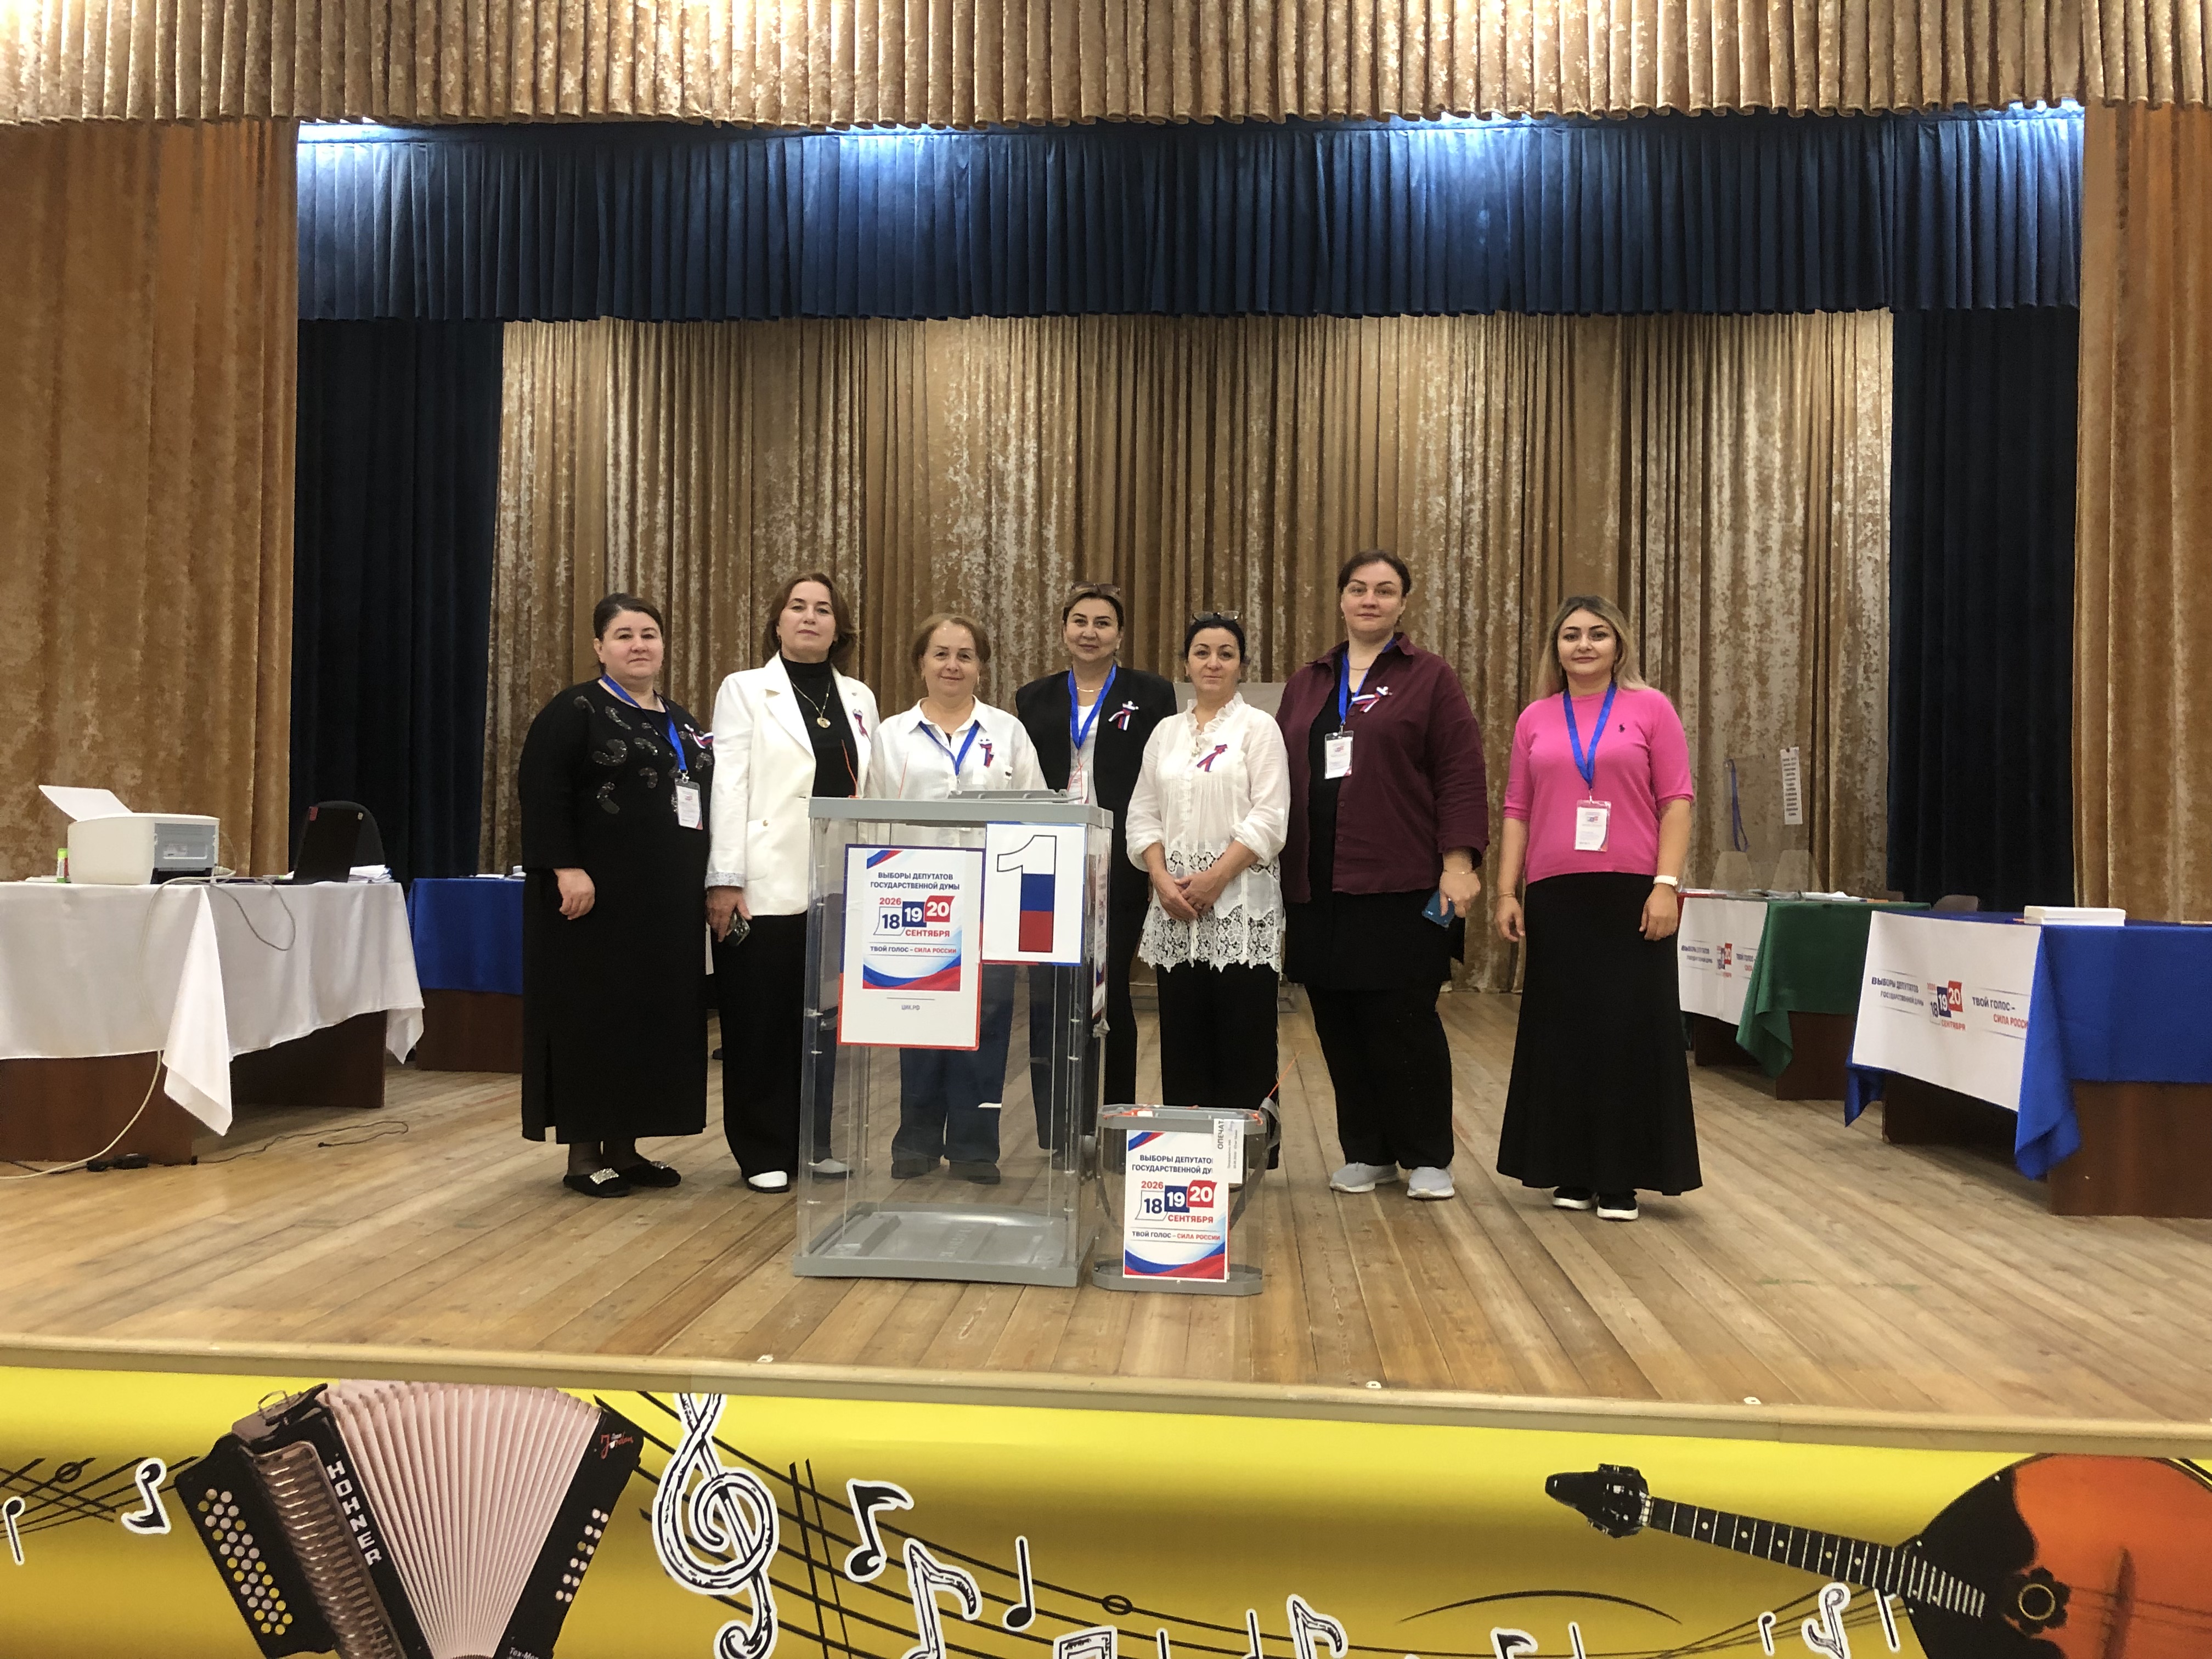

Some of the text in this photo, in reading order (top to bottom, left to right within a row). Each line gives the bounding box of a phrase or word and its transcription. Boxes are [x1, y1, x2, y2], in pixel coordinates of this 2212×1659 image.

[870, 882, 938, 890] ГОСУДАРСТВЕННОЙ
[996, 834, 1057, 953] 1
[879, 897, 901, 905] 2026
[882, 901, 950, 929] 18 19 20
[1871, 976, 1896, 988] ВЫБОРЫ
[1930, 987, 1961, 1018] 18 19 20
[1972, 996, 1989, 1008] ТВОЙ
[1990, 1000, 2011, 1011] ГОЛОС
[1993, 1013, 2028, 1029] СИЛА РОССИ
[1139, 1154, 1213, 1164] ВЫБОРЫ ДЕПУТАТО
[1132, 1164, 1201, 1173] ГОСУДАРСТВЕННОЙ
[1141, 1181, 1164, 1189] 2026
[1144, 1186, 1213, 1214] 18 19 20
[1167, 1214, 1214, 1223] СЕНТЯБРЯ
[326, 1460, 382, 1566] HOHNER
